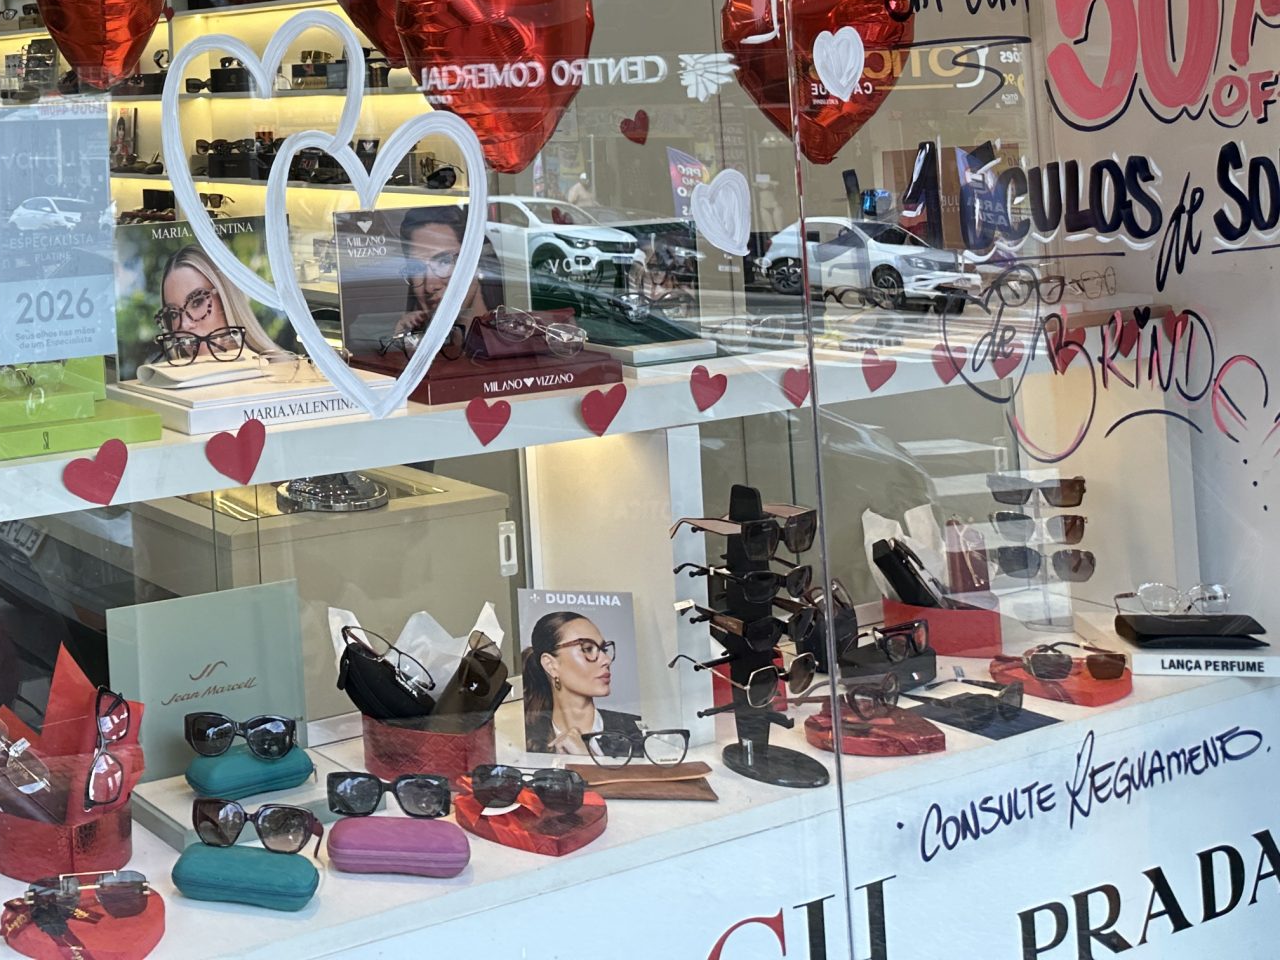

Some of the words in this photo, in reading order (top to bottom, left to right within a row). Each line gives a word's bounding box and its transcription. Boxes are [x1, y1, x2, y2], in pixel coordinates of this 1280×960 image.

[1212, 70, 1280, 120] OF
[1213, 141, 1280, 242] SO
[346, 235, 386, 246] MILANO
[347, 246, 387, 258] VIZZANO
[16, 287, 95, 326] 2026
[483, 377, 522, 393] MILANO
[535, 372, 574, 387] VIZZANO
[545, 593, 622, 607] DUDALINA
[1160, 657, 1201, 675] LANÇA
[1205, 658, 1266, 674] PERFUME
[920, 789, 1057, 862] CONSULTE
[1017, 828, 1280, 960] PRADA
